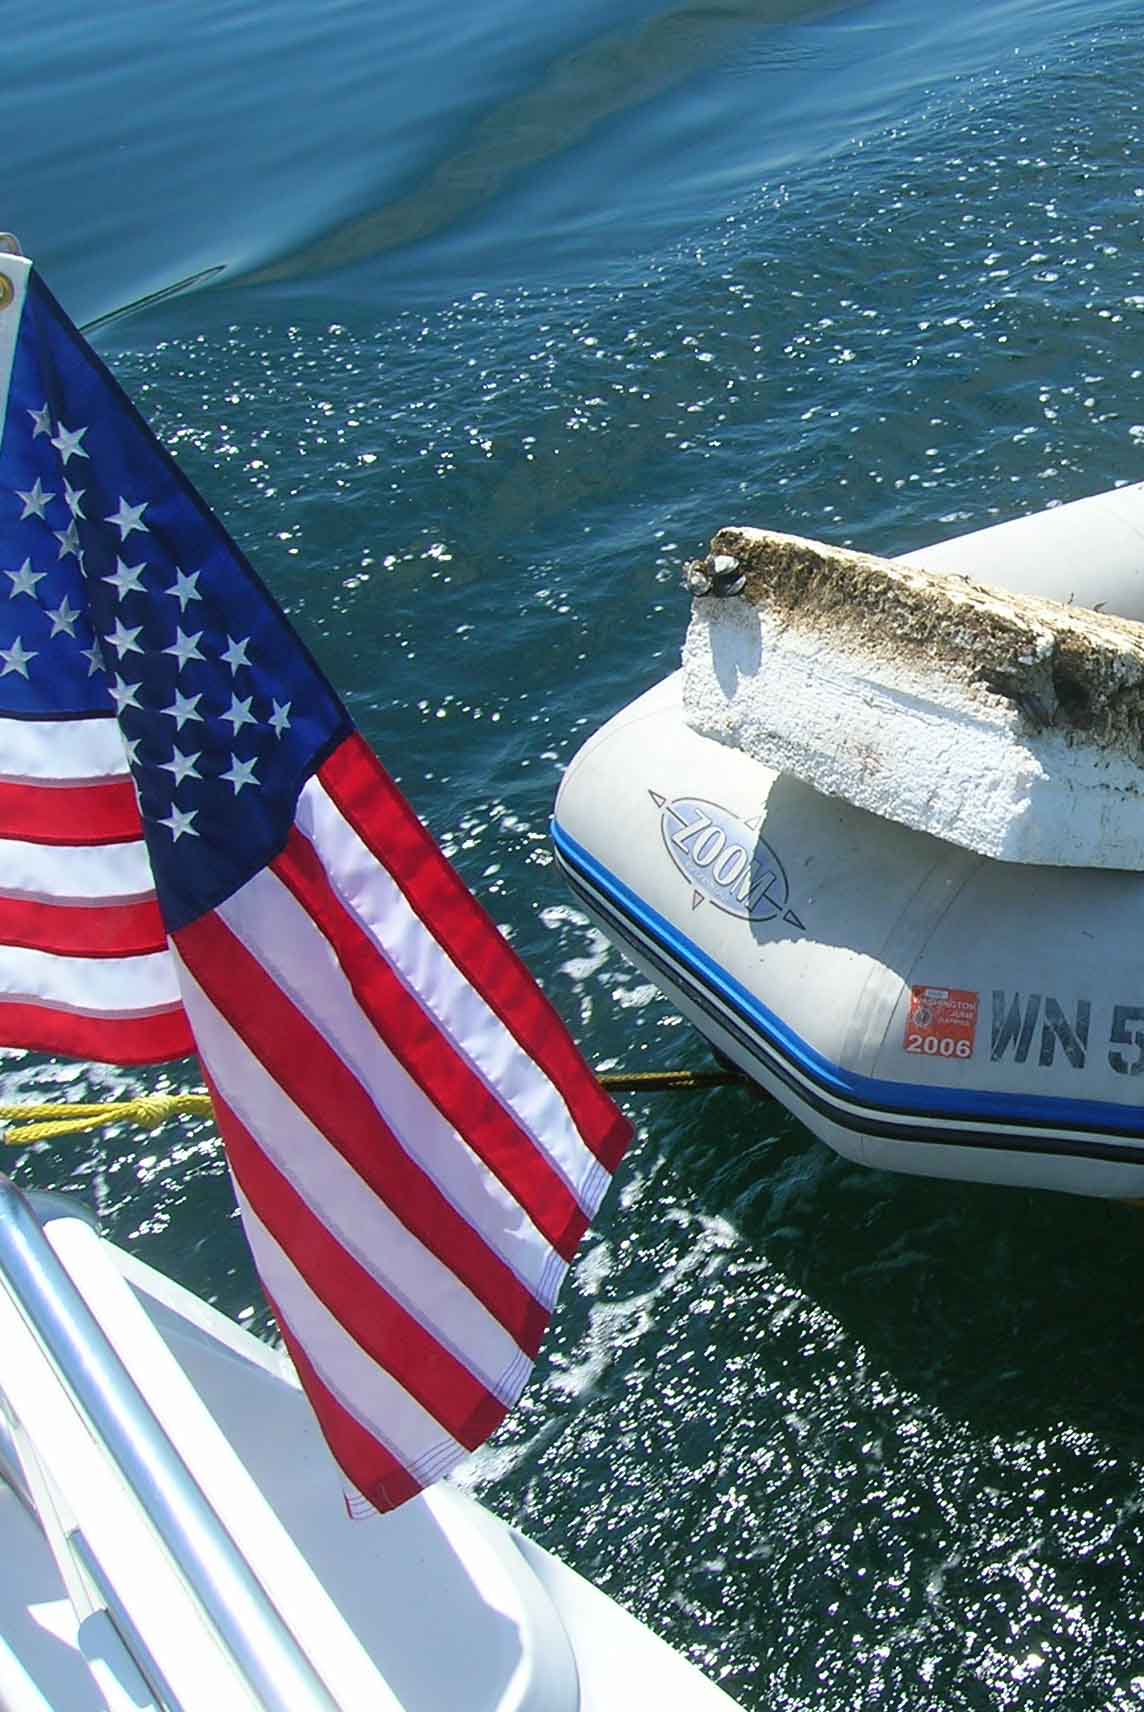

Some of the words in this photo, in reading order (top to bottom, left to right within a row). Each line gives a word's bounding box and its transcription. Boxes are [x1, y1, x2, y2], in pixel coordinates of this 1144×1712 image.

[672, 809, 776, 912] ZOOM
[907, 1035, 971, 1058] 2006
[990, 992, 1091, 1068] WN
